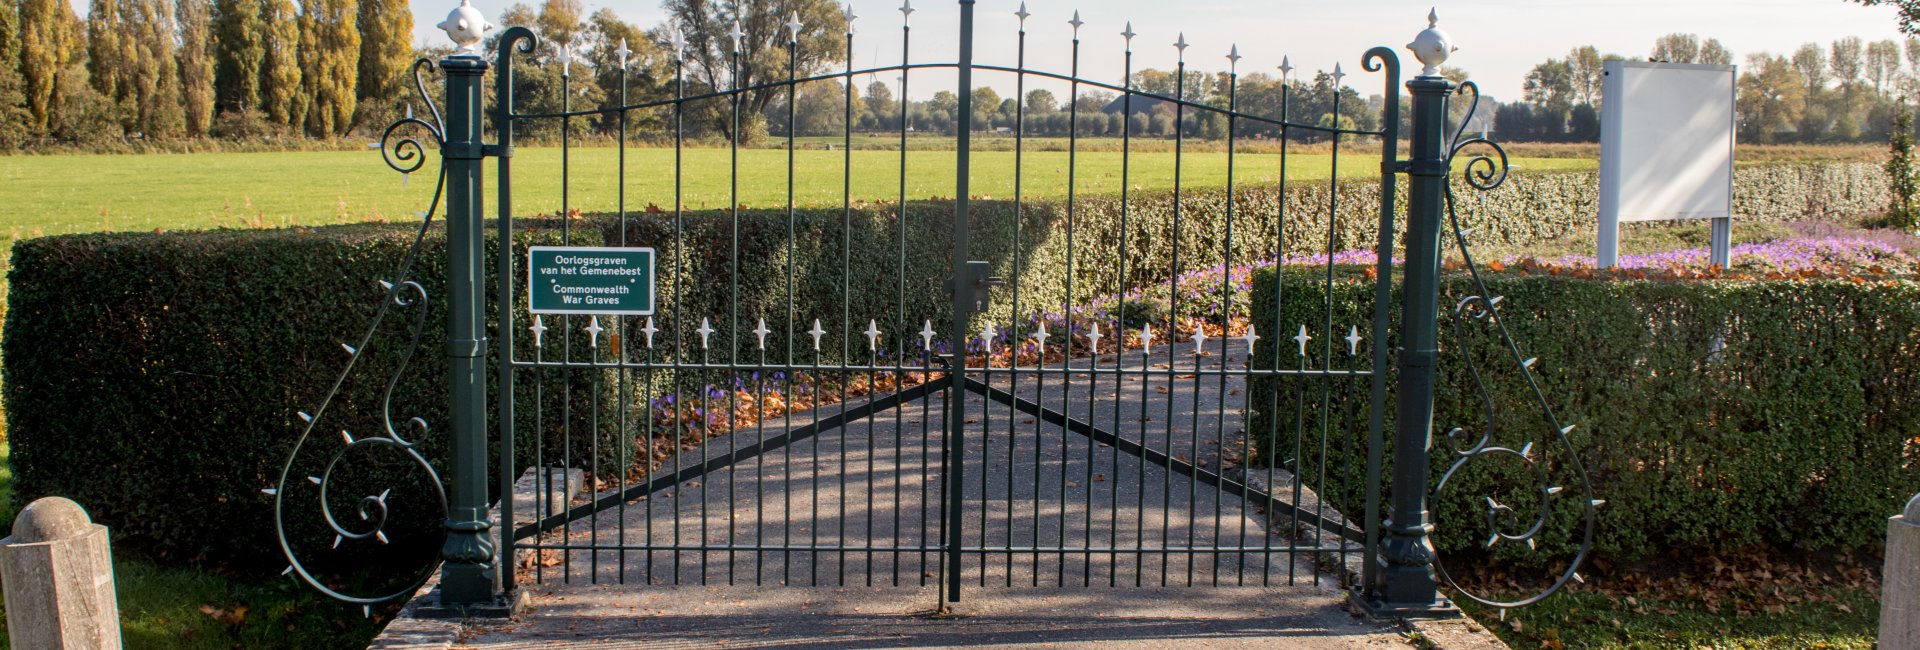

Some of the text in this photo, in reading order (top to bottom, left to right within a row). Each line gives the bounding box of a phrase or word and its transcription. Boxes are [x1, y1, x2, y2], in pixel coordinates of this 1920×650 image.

[555, 255, 627, 266] Oorlogsgraven
[541, 266, 641, 275] van het Gemenebest
[553, 284, 629, 294] Commonwealth
[563, 295, 620, 304] War Graves
